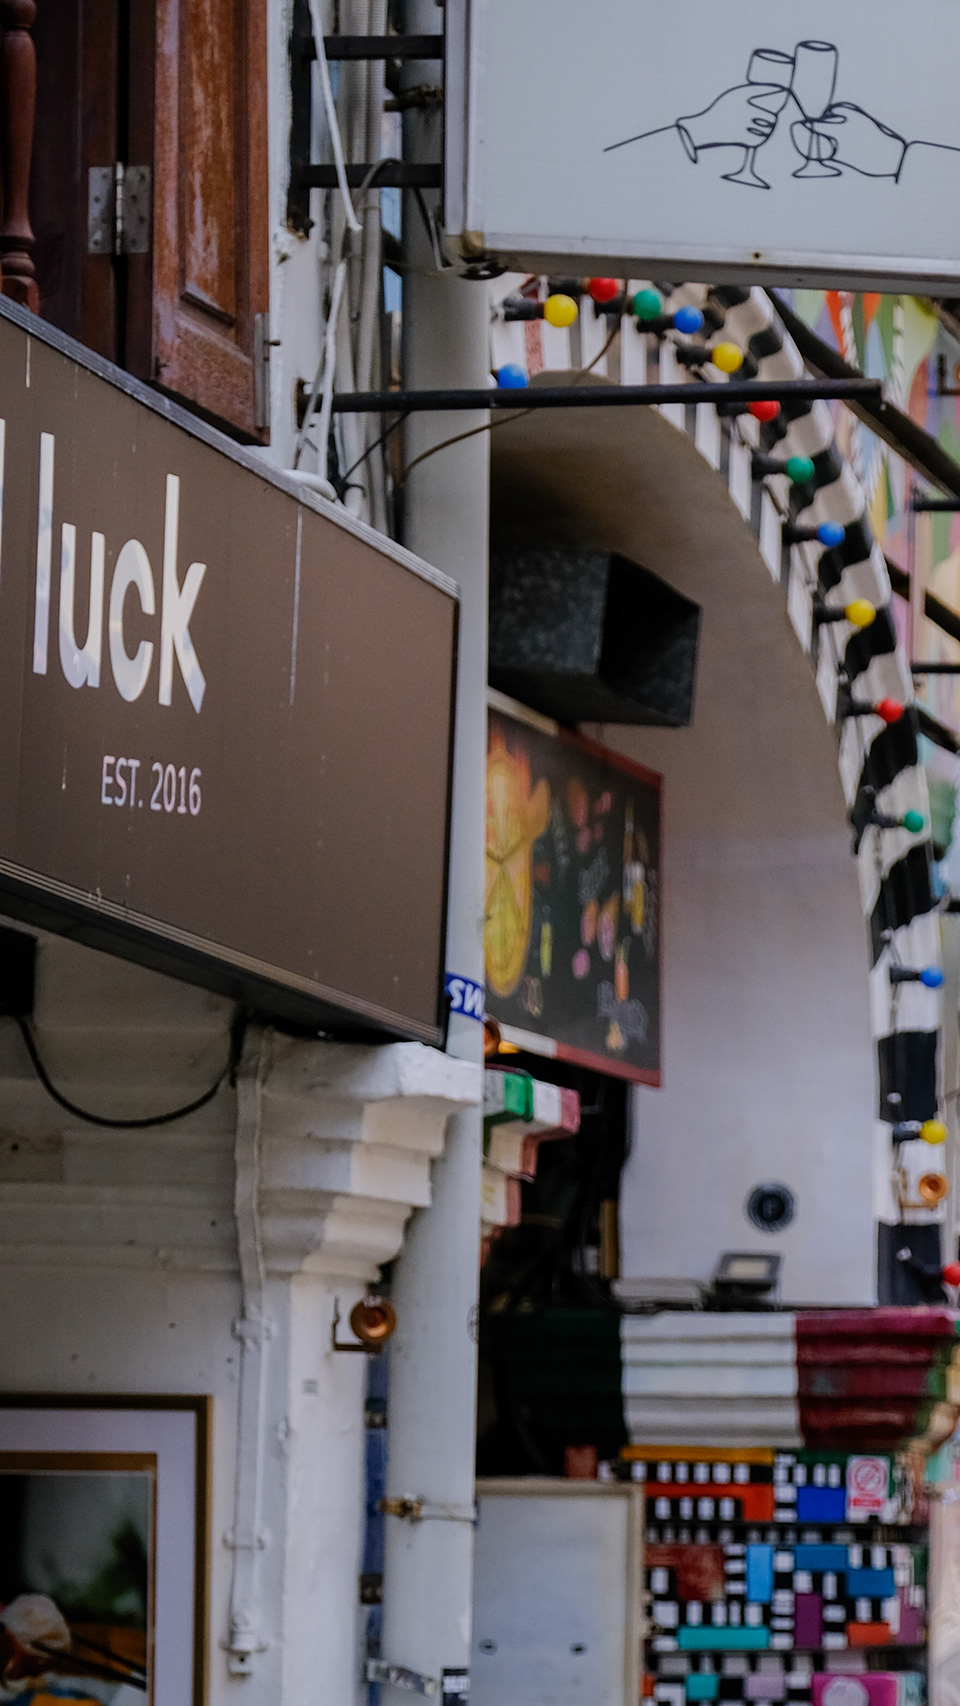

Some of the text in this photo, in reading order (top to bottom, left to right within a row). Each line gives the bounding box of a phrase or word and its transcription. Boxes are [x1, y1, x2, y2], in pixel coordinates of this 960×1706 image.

[33, 432, 207, 714] luck
[101, 755, 202, 816] EST. 2016
